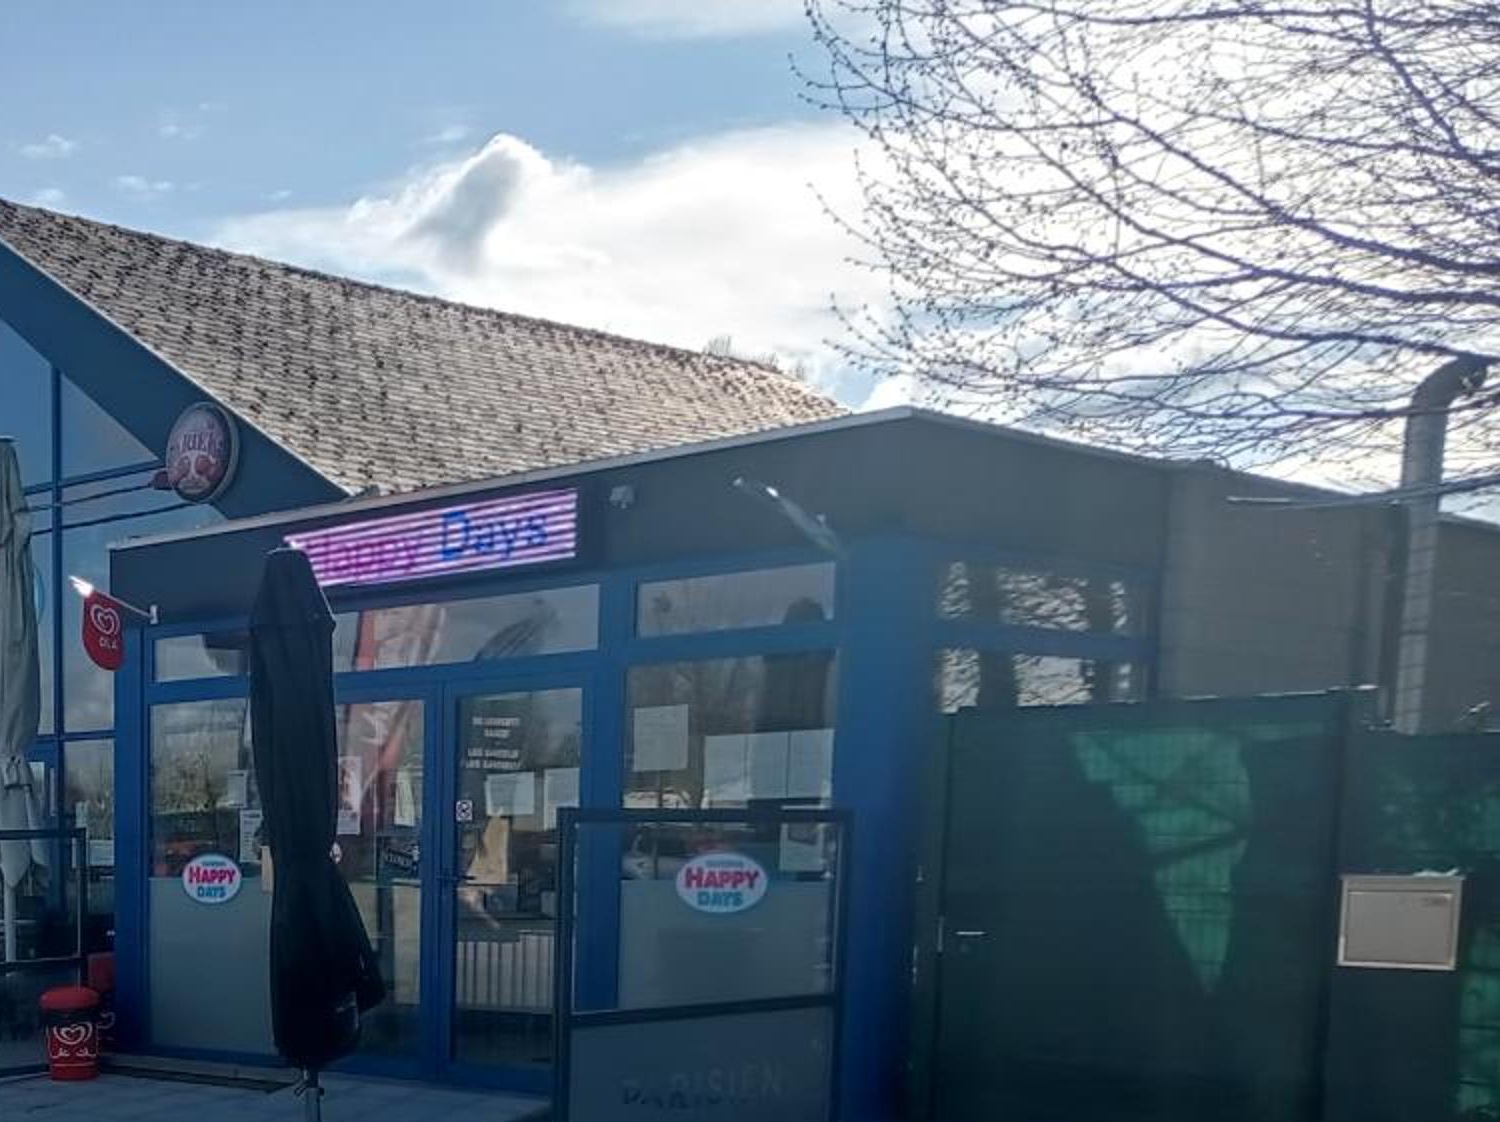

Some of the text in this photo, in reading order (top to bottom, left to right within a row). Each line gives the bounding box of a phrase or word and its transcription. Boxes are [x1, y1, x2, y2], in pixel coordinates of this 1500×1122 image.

[442, 510, 548, 561] Days
[189, 866, 236, 885] HAPPY
[685, 866, 759, 890] HAPPY
[197, 886, 227, 898] DAYS
[698, 891, 743, 907] DAYS
